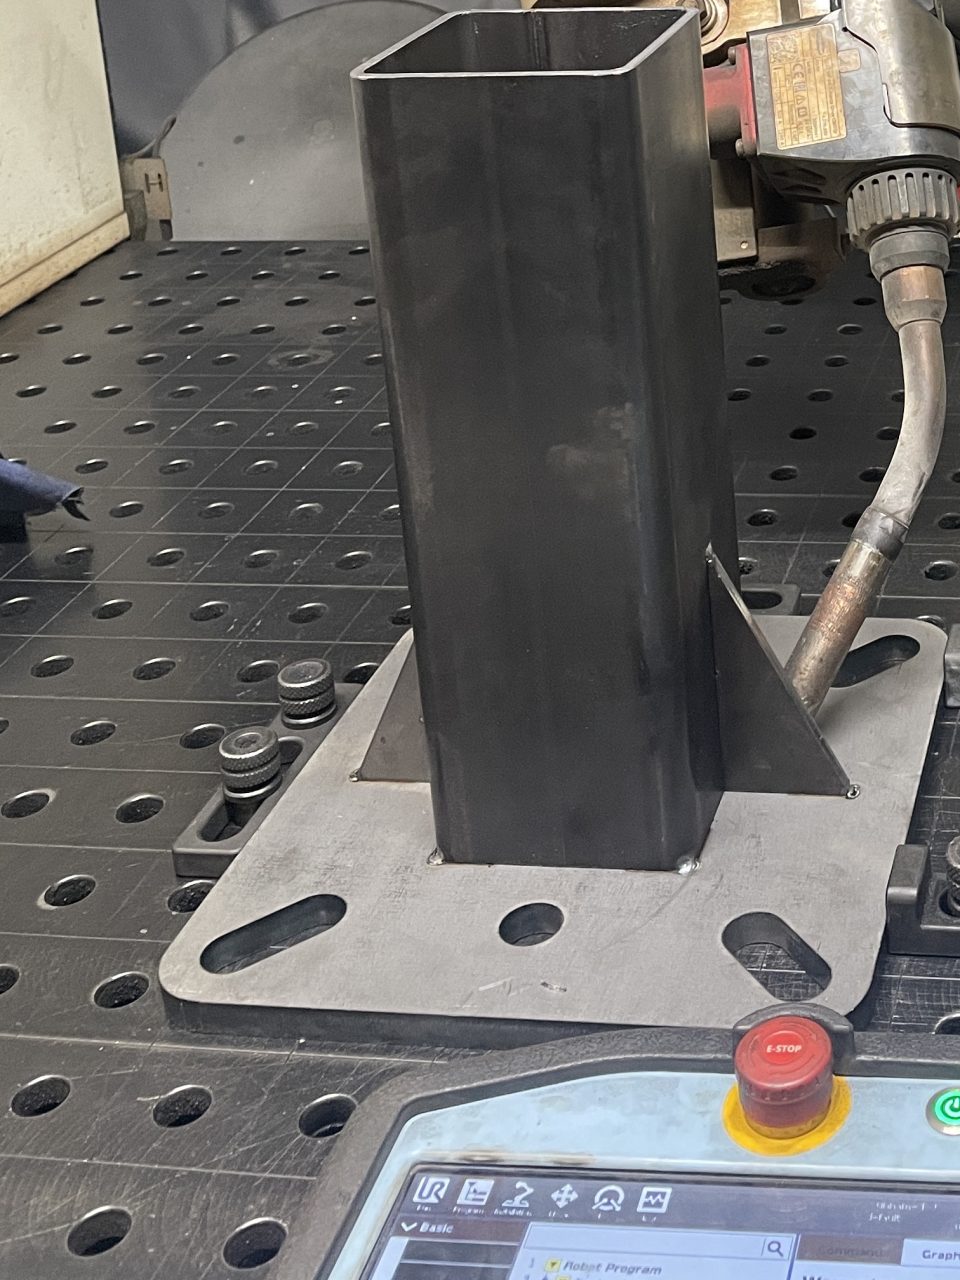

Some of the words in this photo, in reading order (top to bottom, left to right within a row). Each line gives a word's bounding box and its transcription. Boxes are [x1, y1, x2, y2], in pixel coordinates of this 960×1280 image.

[766, 1044, 802, 1054] E-STOP
[419, 1221, 454, 1234] Basic
[562, 1260, 603, 1272] Robot
[604, 1262, 662, 1276] Program
